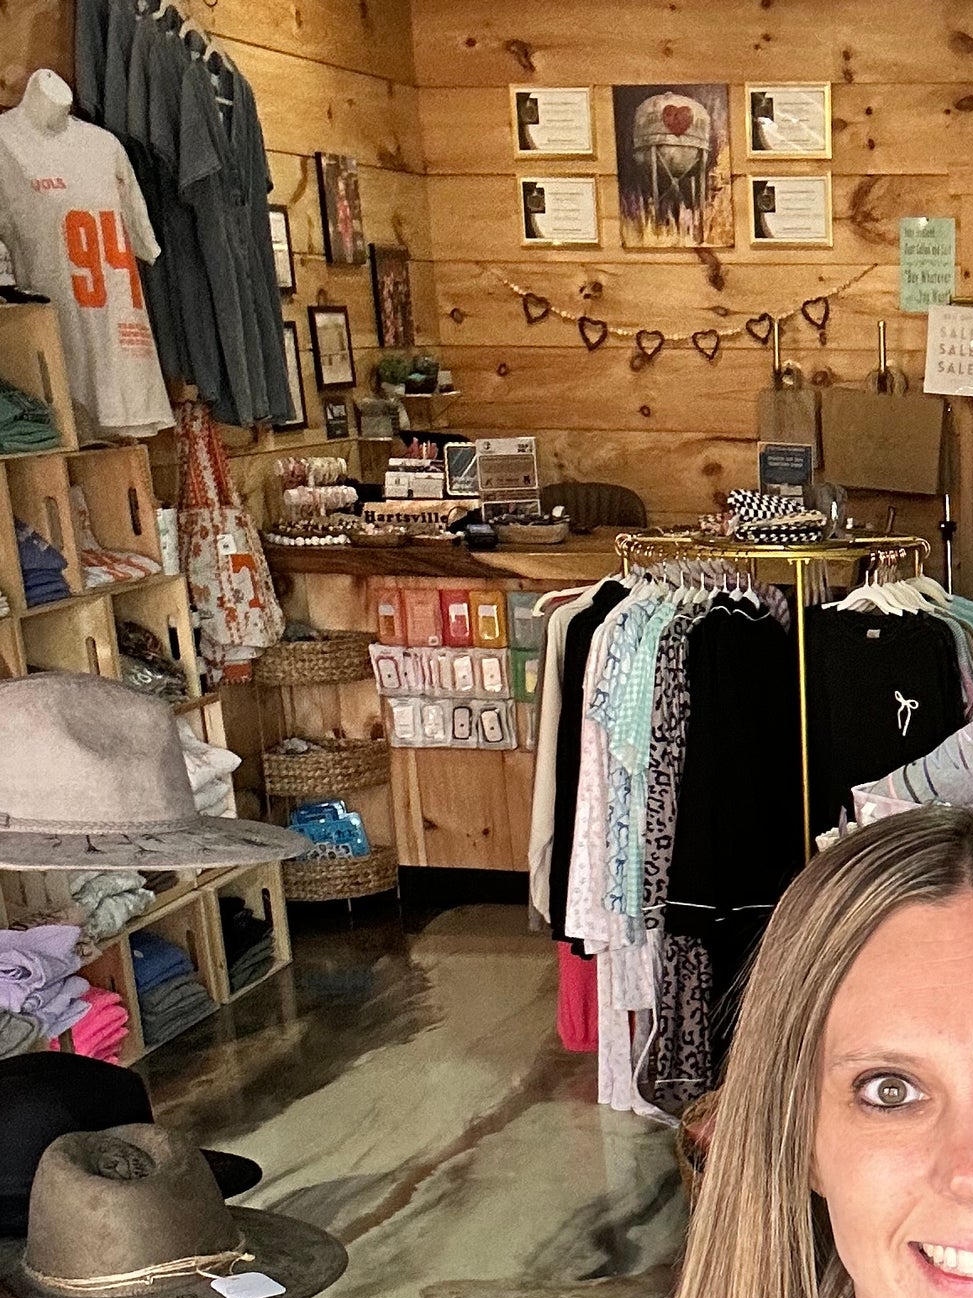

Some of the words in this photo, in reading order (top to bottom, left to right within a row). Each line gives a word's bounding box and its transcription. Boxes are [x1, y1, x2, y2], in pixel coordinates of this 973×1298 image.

[64, 209, 143, 311] 94
[937, 361, 973, 376] SALE
[364, 510, 449, 525] Hartsville
